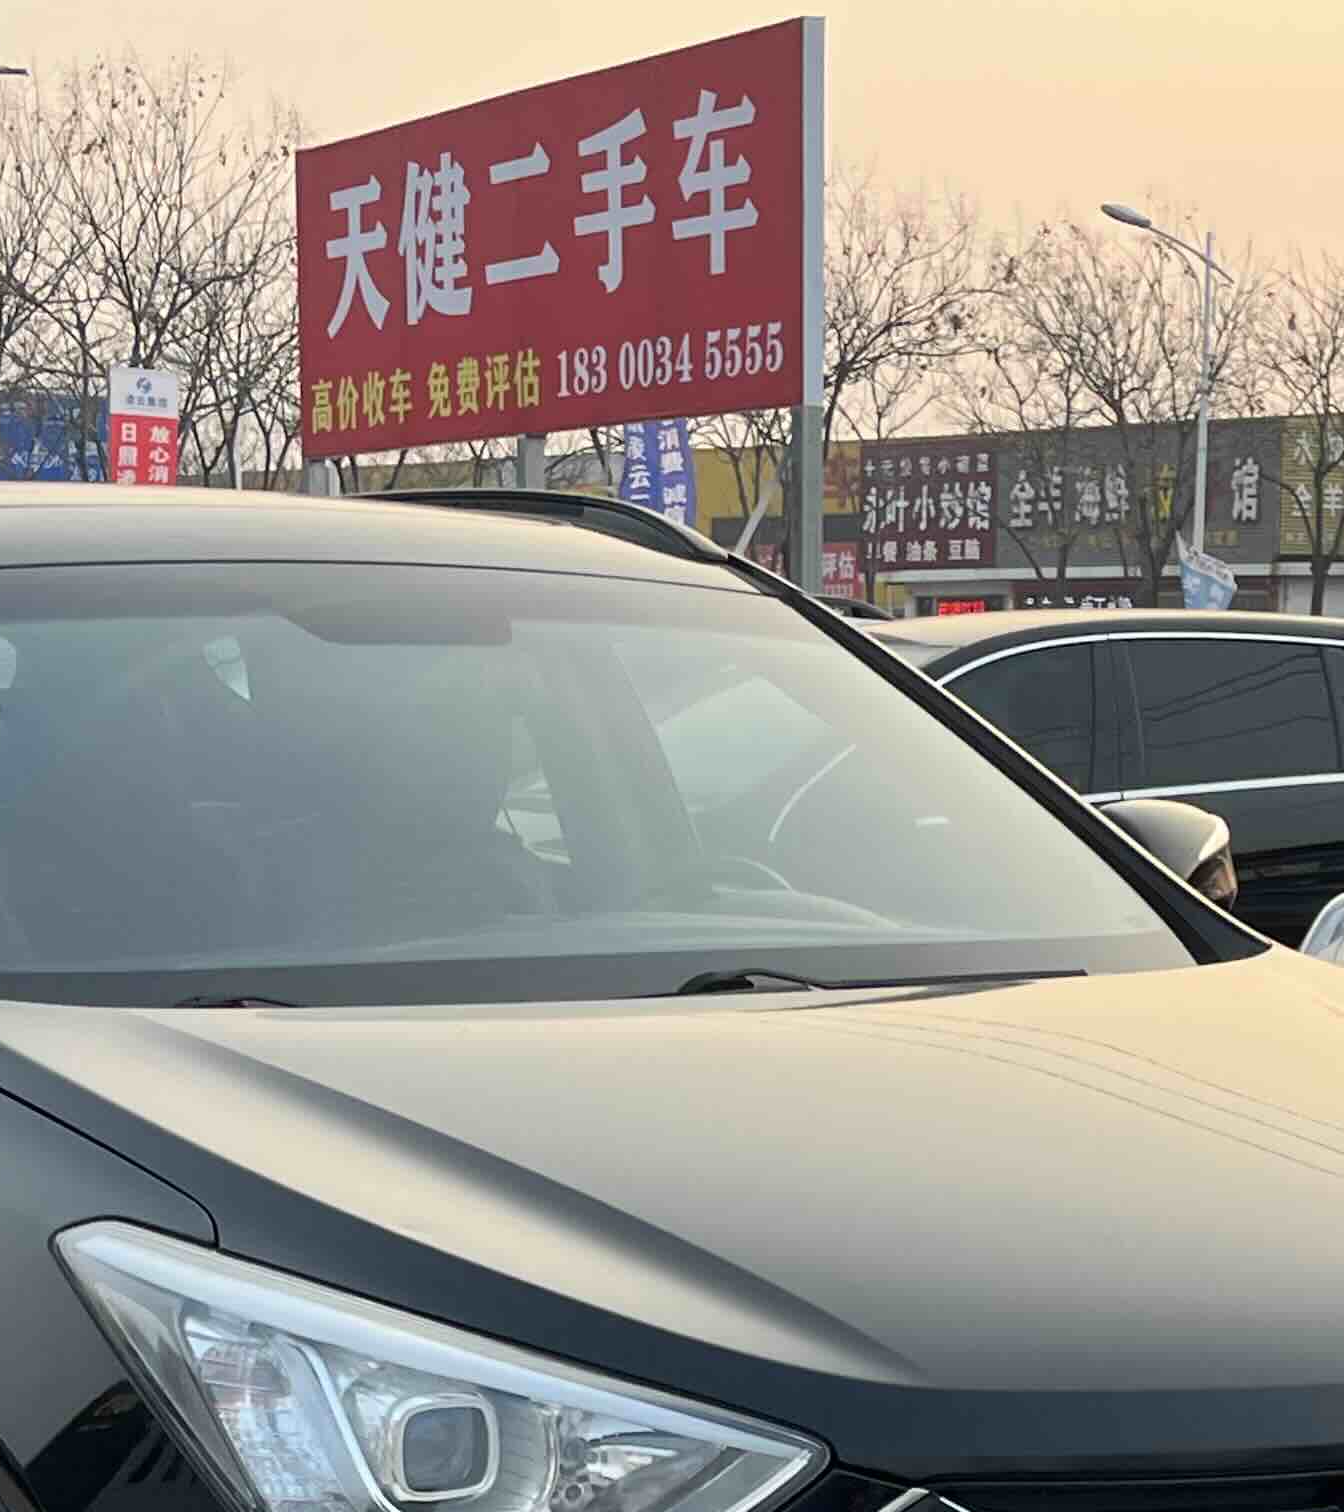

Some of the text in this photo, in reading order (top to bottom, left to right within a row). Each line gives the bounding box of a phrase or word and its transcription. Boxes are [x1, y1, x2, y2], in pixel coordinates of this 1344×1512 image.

[325, 88, 760, 339] 天健二手车
[311, 321, 785, 435] 高价收车 免费评估 183 0034 5555
